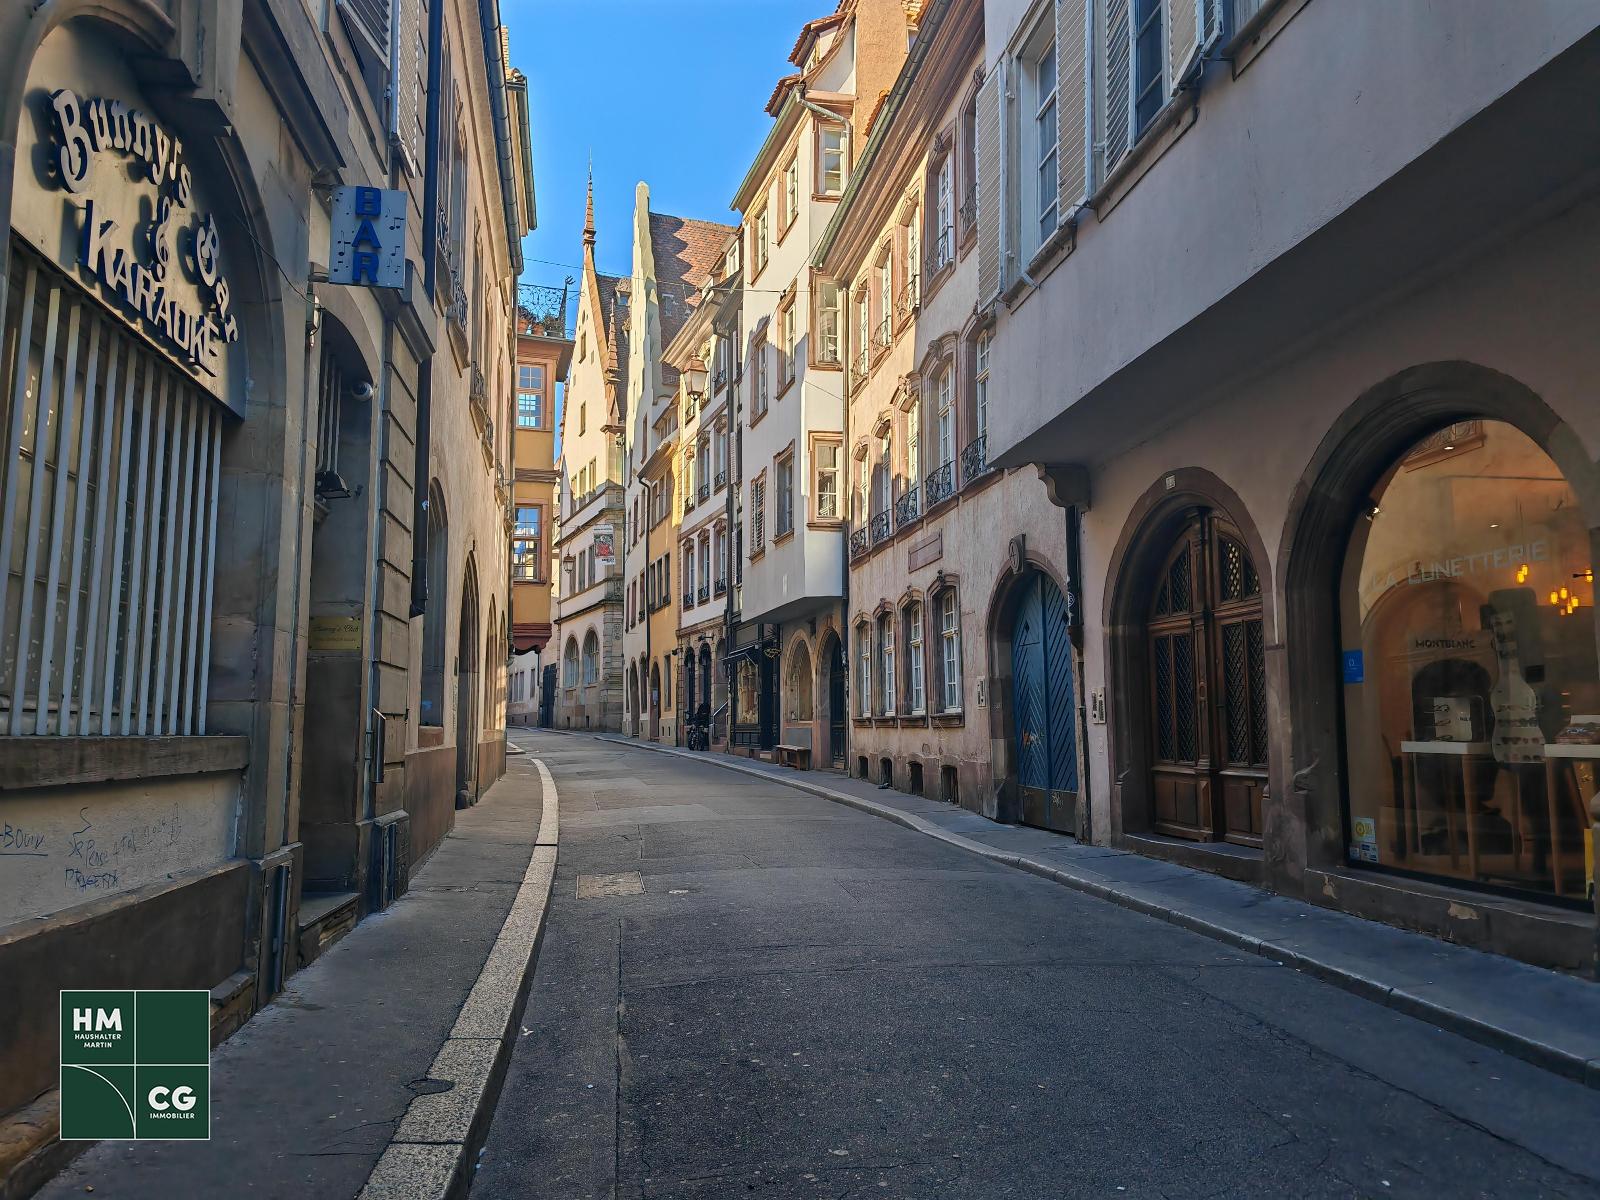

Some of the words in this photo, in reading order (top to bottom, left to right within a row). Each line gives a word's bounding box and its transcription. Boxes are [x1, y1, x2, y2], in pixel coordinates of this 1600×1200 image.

[50, 88, 192, 209] Bunny's
[196, 212, 239, 343] Bar
[351, 186, 382, 284] BAR
[1407, 540, 1549, 586] LUNETTERIE
[1415, 639, 1475, 649] MONTBLANC
